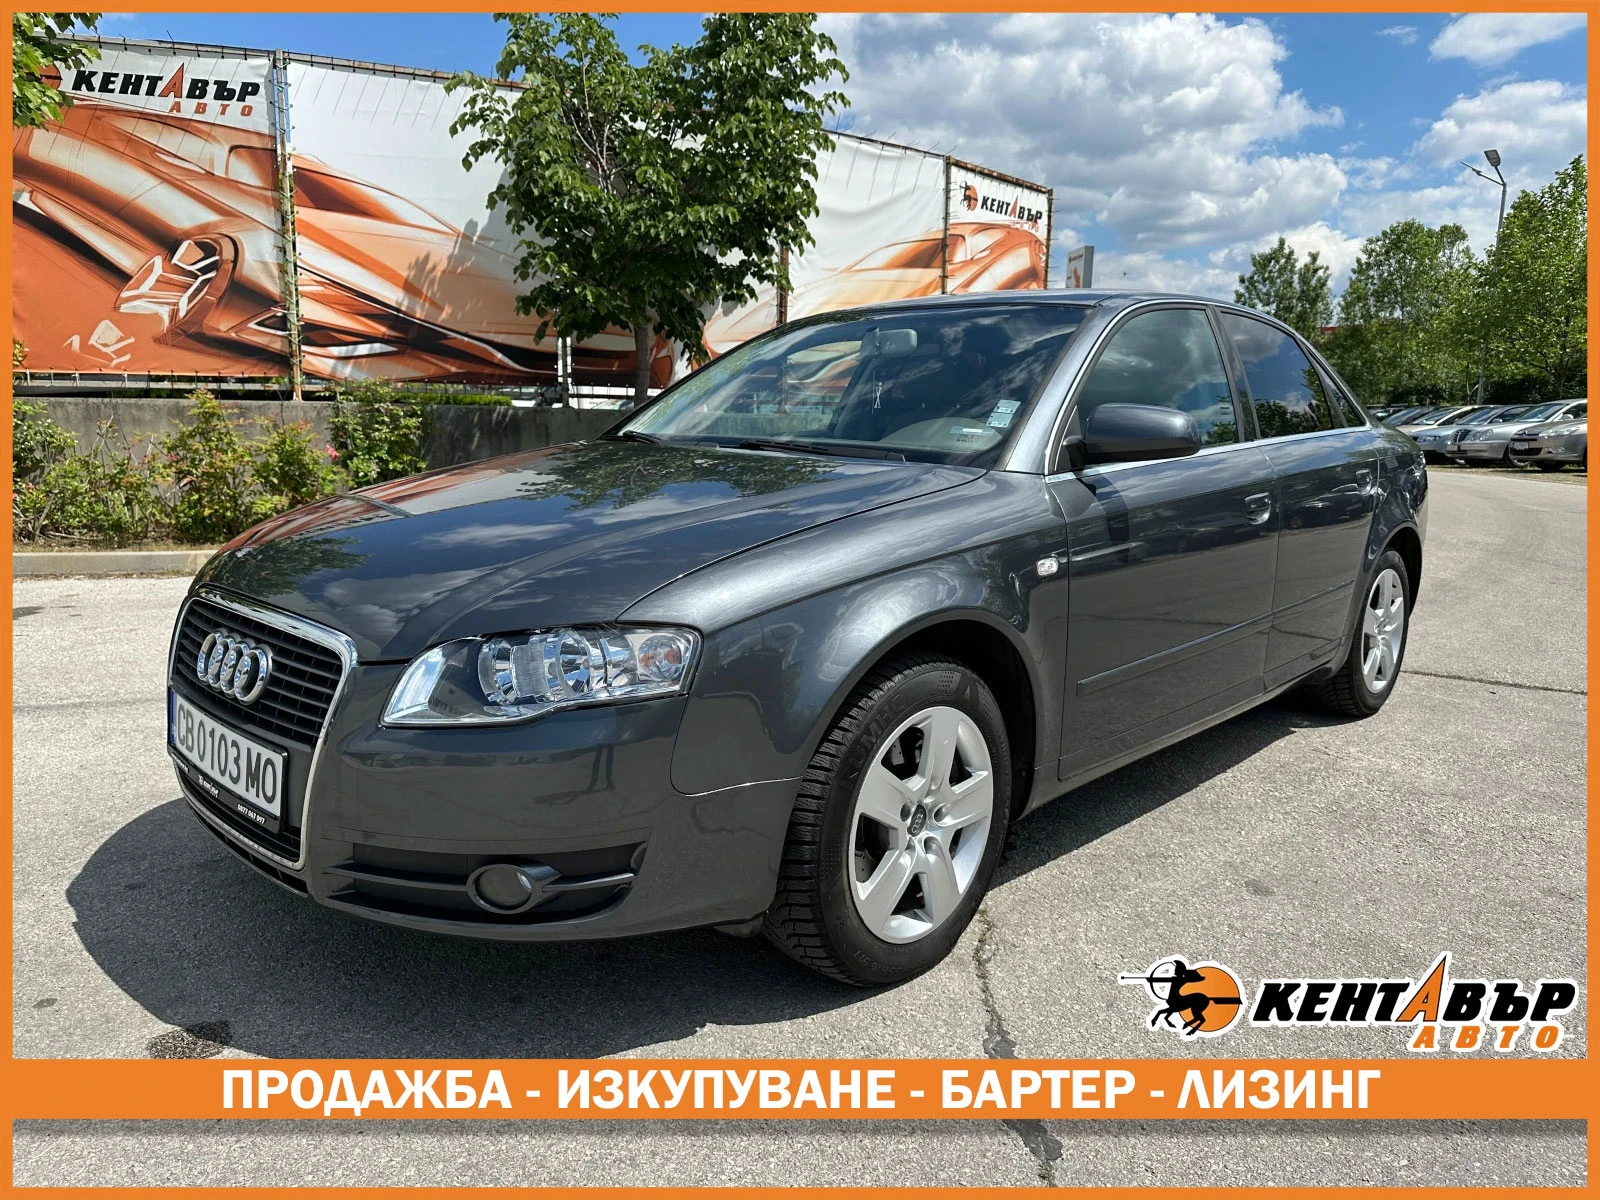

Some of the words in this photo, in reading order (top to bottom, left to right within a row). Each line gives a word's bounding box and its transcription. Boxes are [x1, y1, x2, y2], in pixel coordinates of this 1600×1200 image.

[71, 62, 260, 102] КЕНТАВЪР
[169, 101, 253, 117] АВТО
[980, 195, 1043, 224] КЕНТАВЪР
